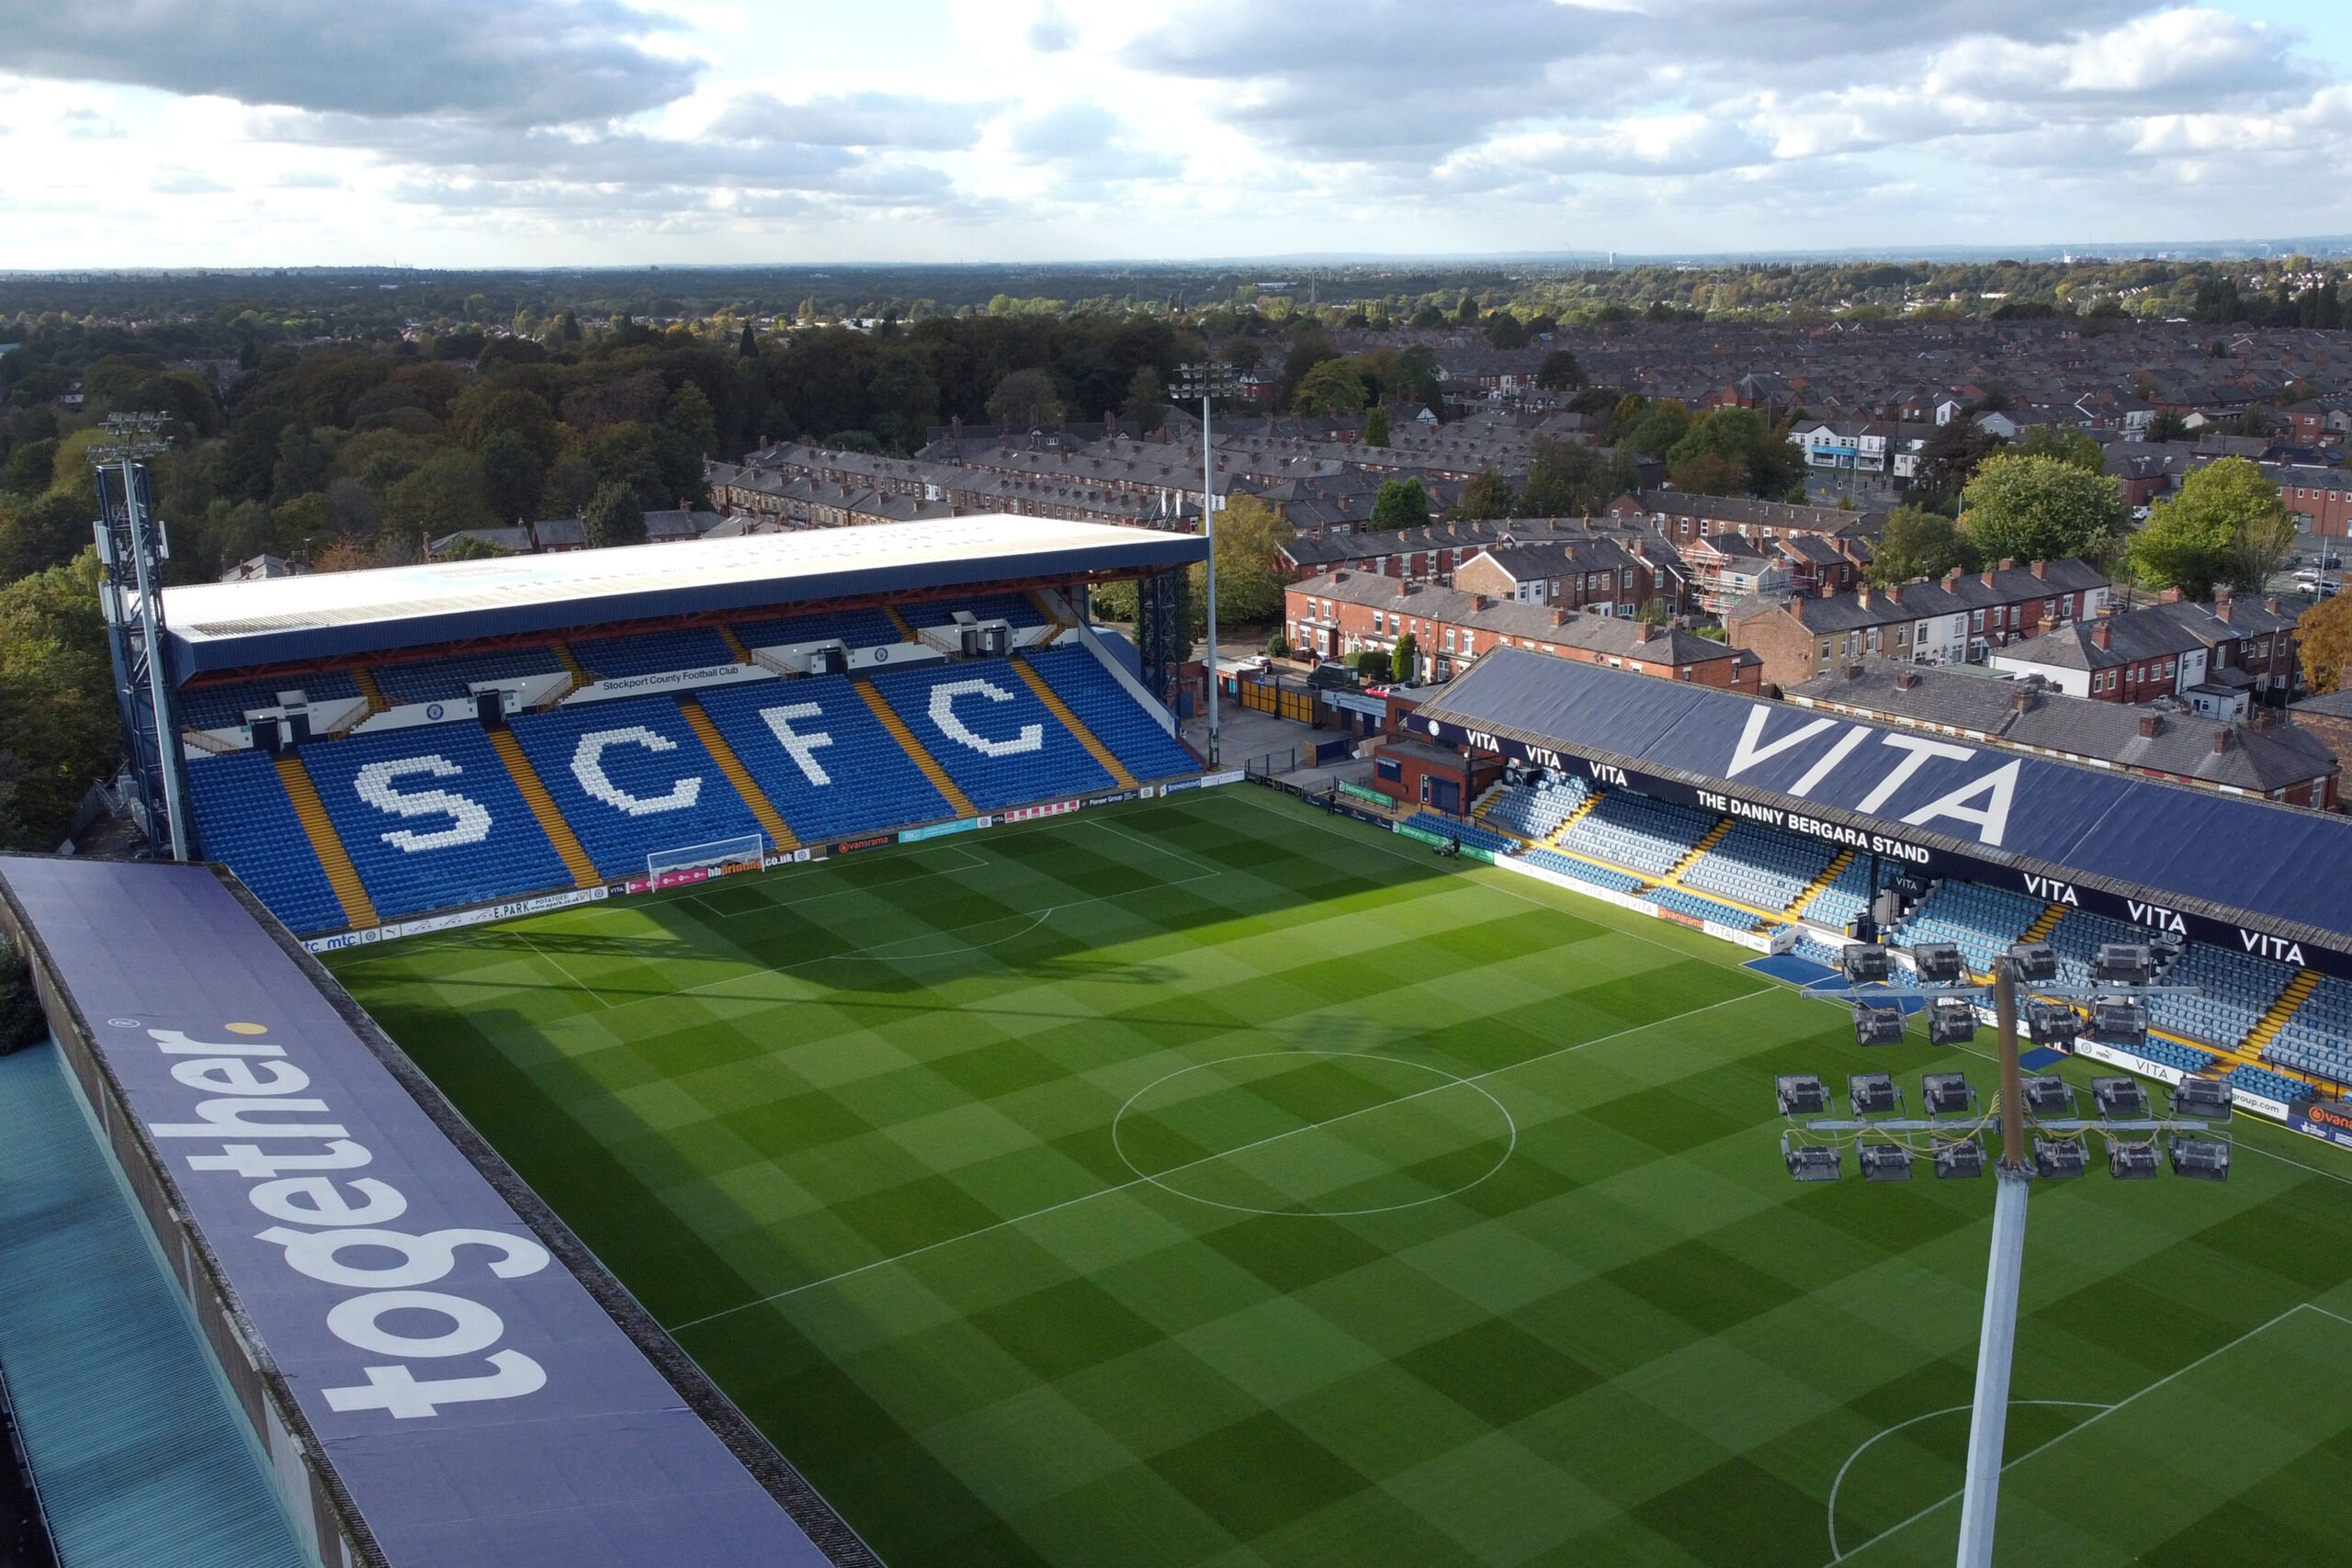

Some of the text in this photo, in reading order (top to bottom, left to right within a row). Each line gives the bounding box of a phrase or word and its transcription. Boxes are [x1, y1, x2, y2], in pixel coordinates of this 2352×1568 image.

[603, 666, 739, 691] Stockport County Football Club
[1465, 728, 1500, 753] VITA
[1525, 744, 1562, 770] VITA
[1589, 761, 1628, 787] VITA
[1724, 704, 2022, 847] VITA
[1696, 789, 1930, 865] THE DANNY BERGARA STAND
[609, 886, 625, 895] VITA
[1895, 876, 1918, 891] VITA
[2023, 874, 2079, 907] VITA
[493, 901, 530, 919] E.PARK
[1632, 900, 1653, 914] VITA
[2127, 900, 2188, 935] VITA
[1666, 910, 1704, 929] vanarama
[1709, 921, 1732, 939] VITA
[303, 940, 320, 953] tc
[327, 934, 356, 950] mtc
[2240, 929, 2305, 966] VITA
[2135, 1058, 2168, 1080] VITA
[2232, 1092, 2279, 1114] group.com
